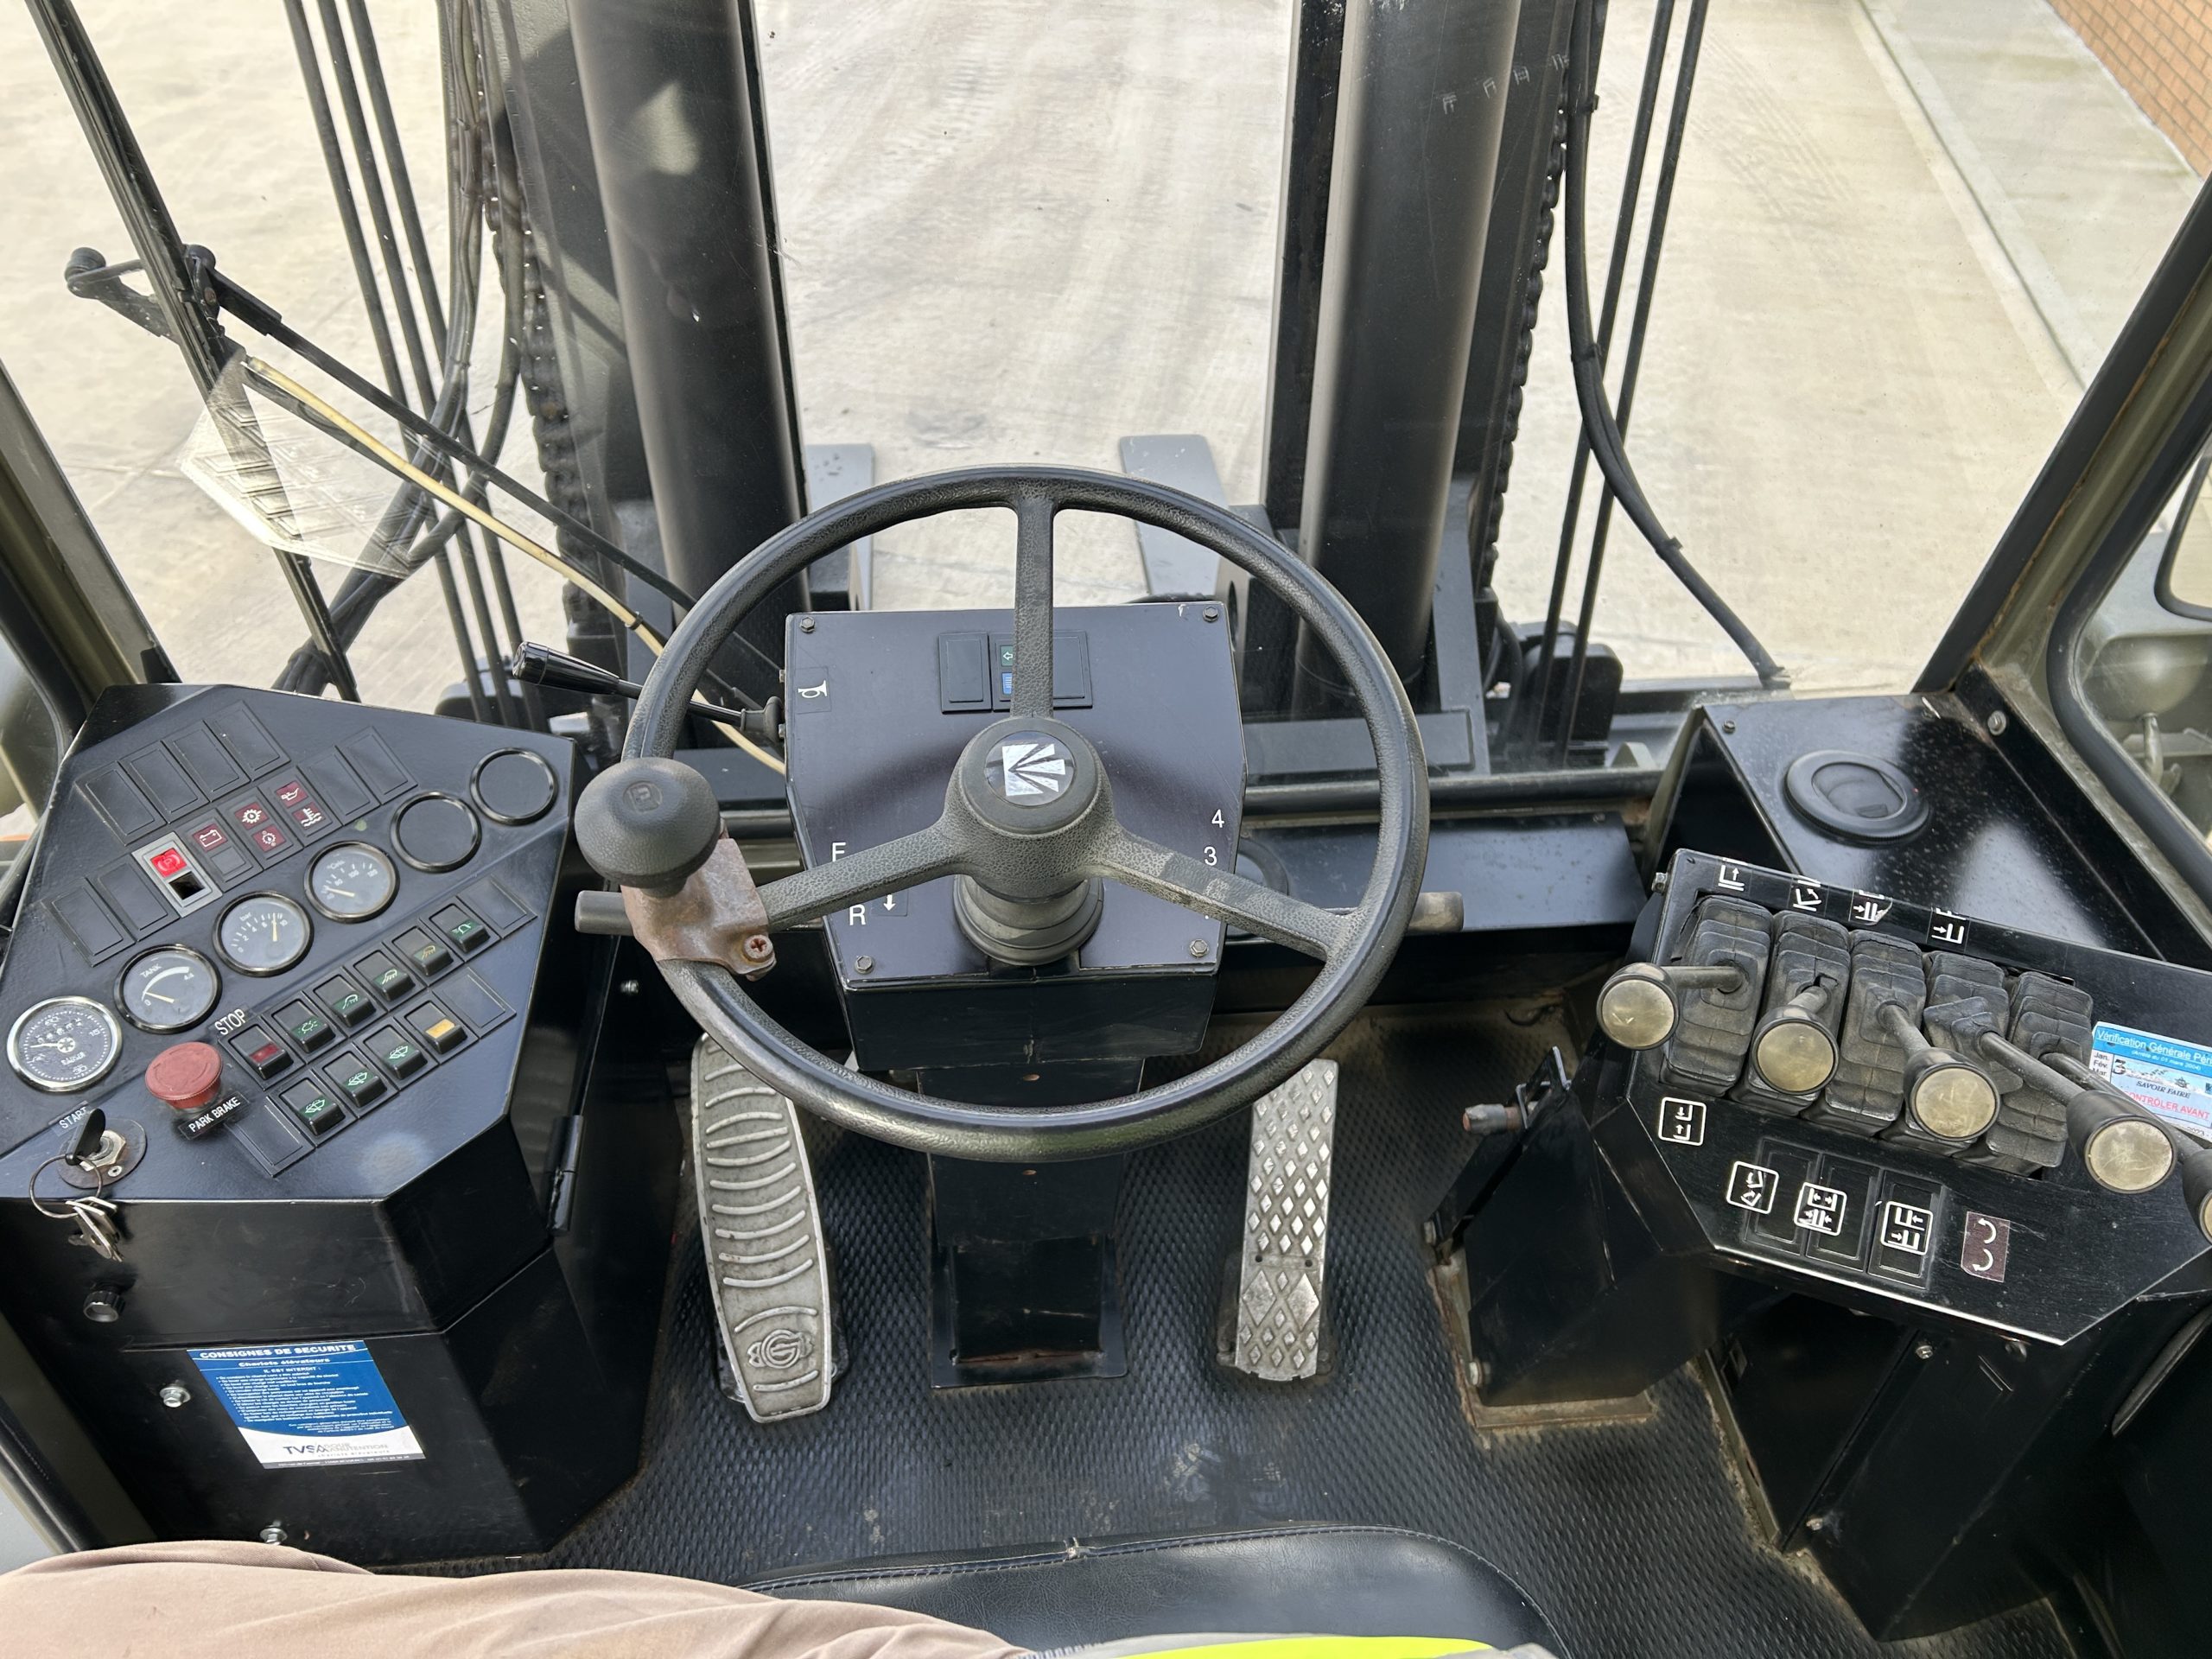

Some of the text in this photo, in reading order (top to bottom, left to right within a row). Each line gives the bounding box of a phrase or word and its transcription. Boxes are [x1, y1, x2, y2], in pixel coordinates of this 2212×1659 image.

[1211, 809, 1225, 829] 4
[832, 842, 847, 862] F
[1204, 846, 1217, 867] 3
[849, 904, 867, 926] R
[140, 963, 162, 978] TANK
[214, 1008, 246, 1035] STOP
[2097, 1029, 2146, 1049] Vérification
[2149, 1041, 2191, 1061] Générale
[2136, 1080, 2191, 1099] SAVOIR FAIRE
[188, 1096, 241, 1133] PARK BRAKE
[2125, 1091, 2210, 1120] ONTRÔLER AVANT
[59, 1106, 87, 1129] START
[200, 1344, 356, 1360] CONSIGNES DE SECURITE
